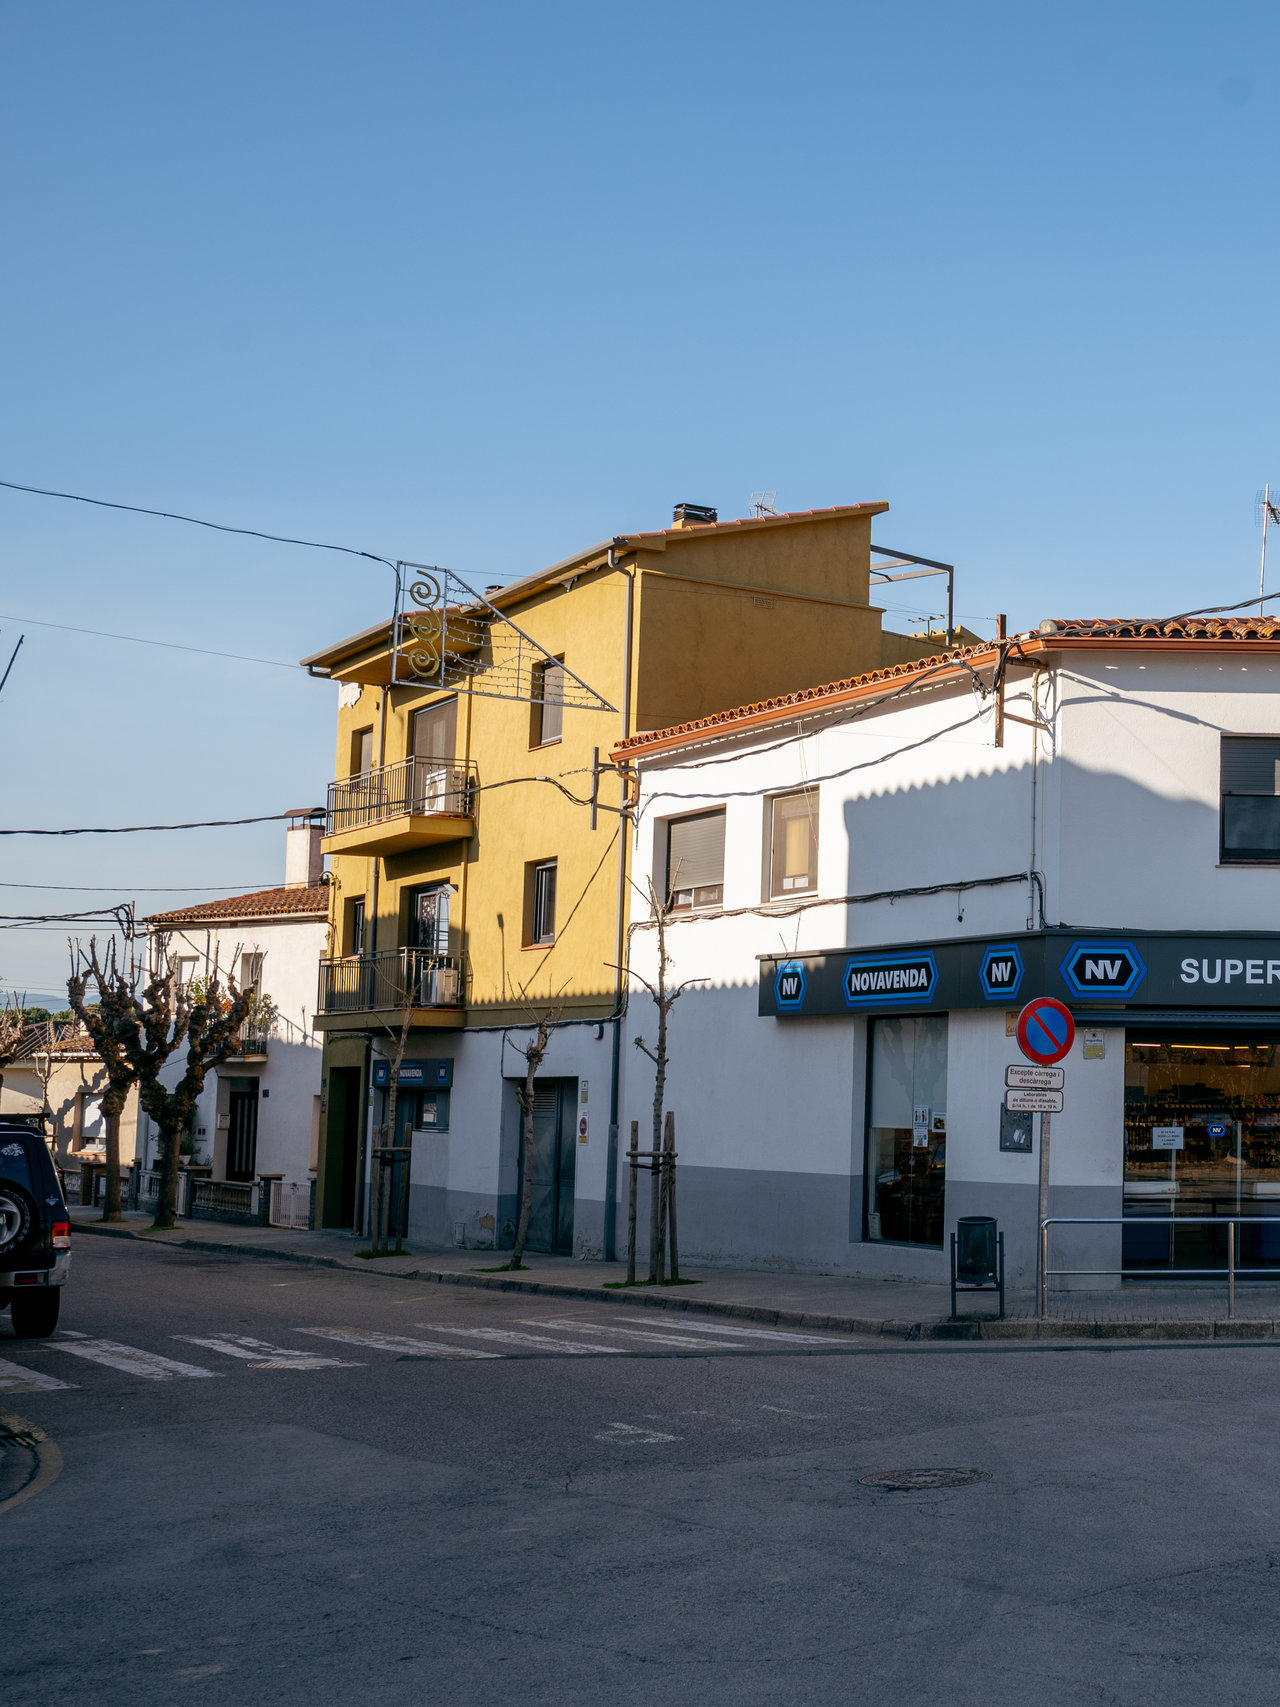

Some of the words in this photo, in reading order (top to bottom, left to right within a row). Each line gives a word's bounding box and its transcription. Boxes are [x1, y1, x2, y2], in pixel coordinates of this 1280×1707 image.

[991, 961, 1012, 983] NV
[1085, 959, 1123, 980] NV
[782, 977, 798, 996] NV
[851, 967, 928, 992] NOVAVENDA
[399, 1069, 422, 1077] NOVAVENDA
[1010, 1068, 1033, 1077] Excepte
[1034, 1070, 1056, 1078] càrrega
[1019, 1077, 1051, 1086] descàrrega
